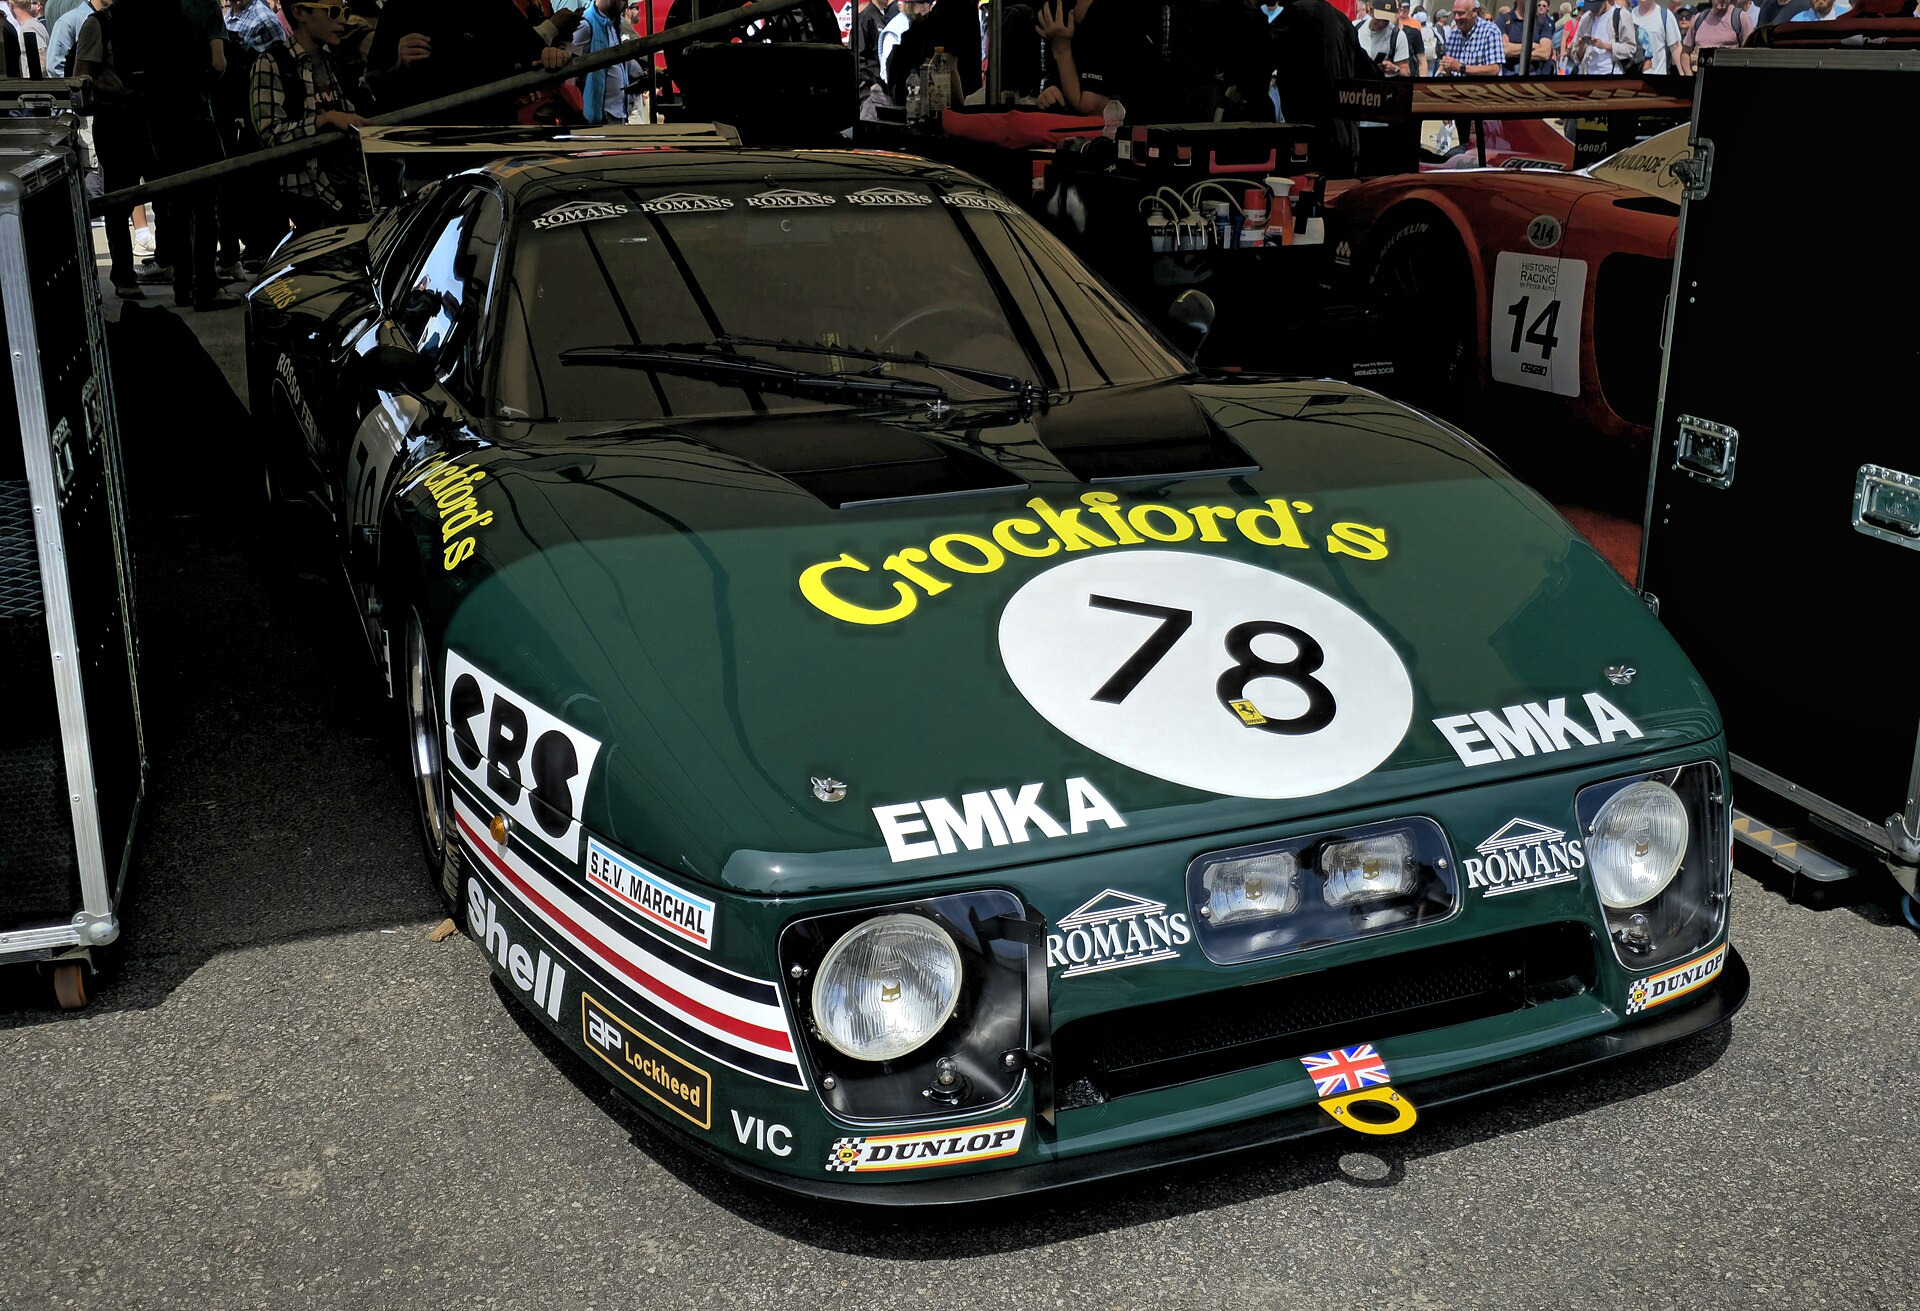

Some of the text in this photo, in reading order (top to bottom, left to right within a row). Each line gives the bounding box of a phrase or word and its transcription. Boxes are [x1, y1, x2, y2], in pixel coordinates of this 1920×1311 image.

[1338, 88, 1382, 106] worten
[531, 203, 629, 230] ROMANS
[640, 198, 734, 213] ROMANS
[744, 194, 837, 208] ROMANS
[844, 193, 933, 206] ROMANS
[1530, 222, 1555, 242] 214
[1519, 271, 1557, 286] RACING
[1521, 262, 1557, 275] HISTORIC
[1507, 295, 1561, 361] 14
[275, 352, 302, 406] ROSSO
[798, 490, 1390, 626] Crockford's
[1087, 592, 1338, 737] 78
[1431, 691, 1645, 768] EMKA
[449, 672, 579, 838] CBS
[871, 776, 1127, 864] EMKA
[1462, 839, 1586, 889] ROMANS
[629, 875, 706, 935] MARCHAL
[467, 876, 566, 1023] Shell
[1046, 912, 1192, 968] ROMANS
[1651, 952, 1724, 999] DUNLOP
[624, 1041, 701, 1109] Lockheed
[730, 1109, 793, 1158] VIC
[864, 1127, 1016, 1163] DUNLOP
